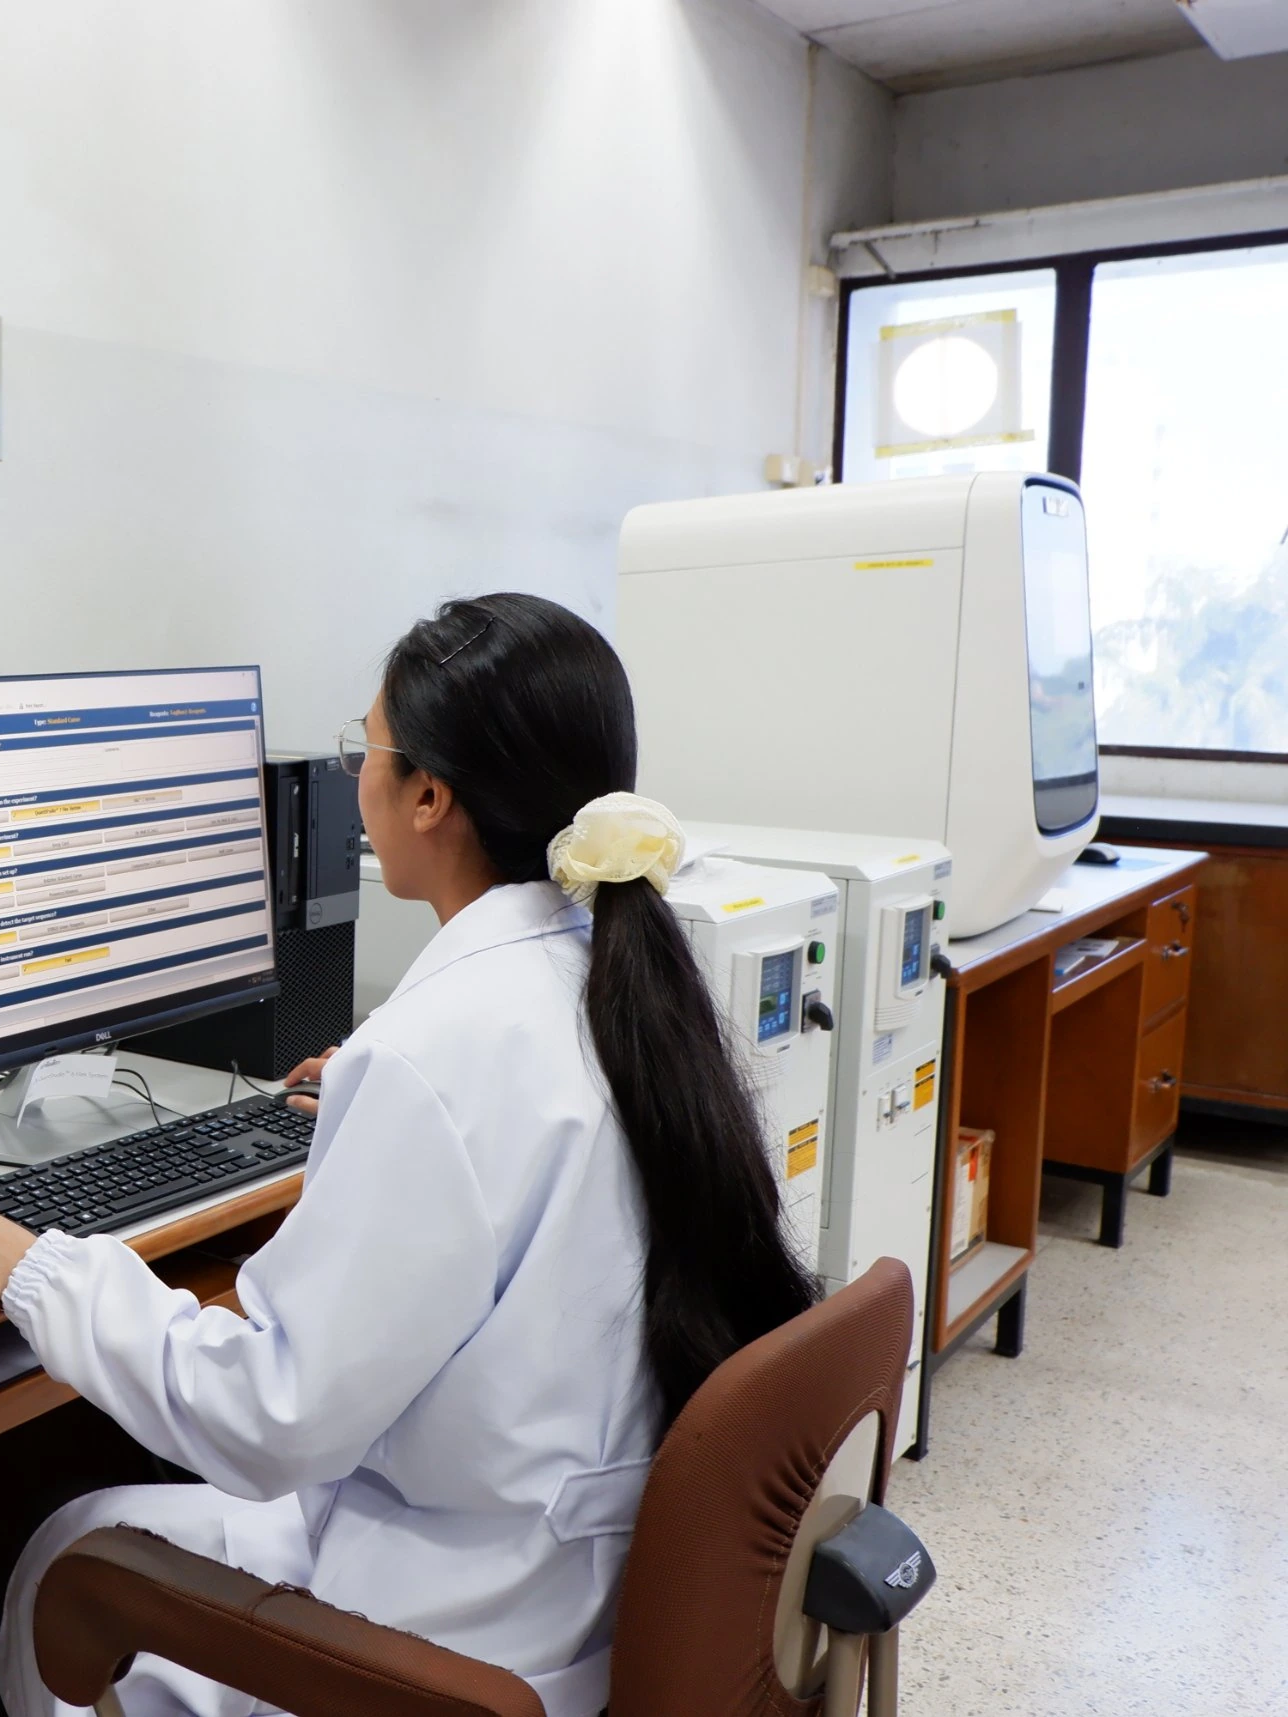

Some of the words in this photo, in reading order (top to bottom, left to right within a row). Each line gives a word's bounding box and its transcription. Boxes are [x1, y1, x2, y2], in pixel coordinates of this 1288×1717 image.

[11, 796, 38, 805] experiment?
[22, 916, 35, 925] target
[35, 913, 57, 922] sequence?
[0, 953, 23, 963] instrument
[96, 1033, 111, 1042] DELL
